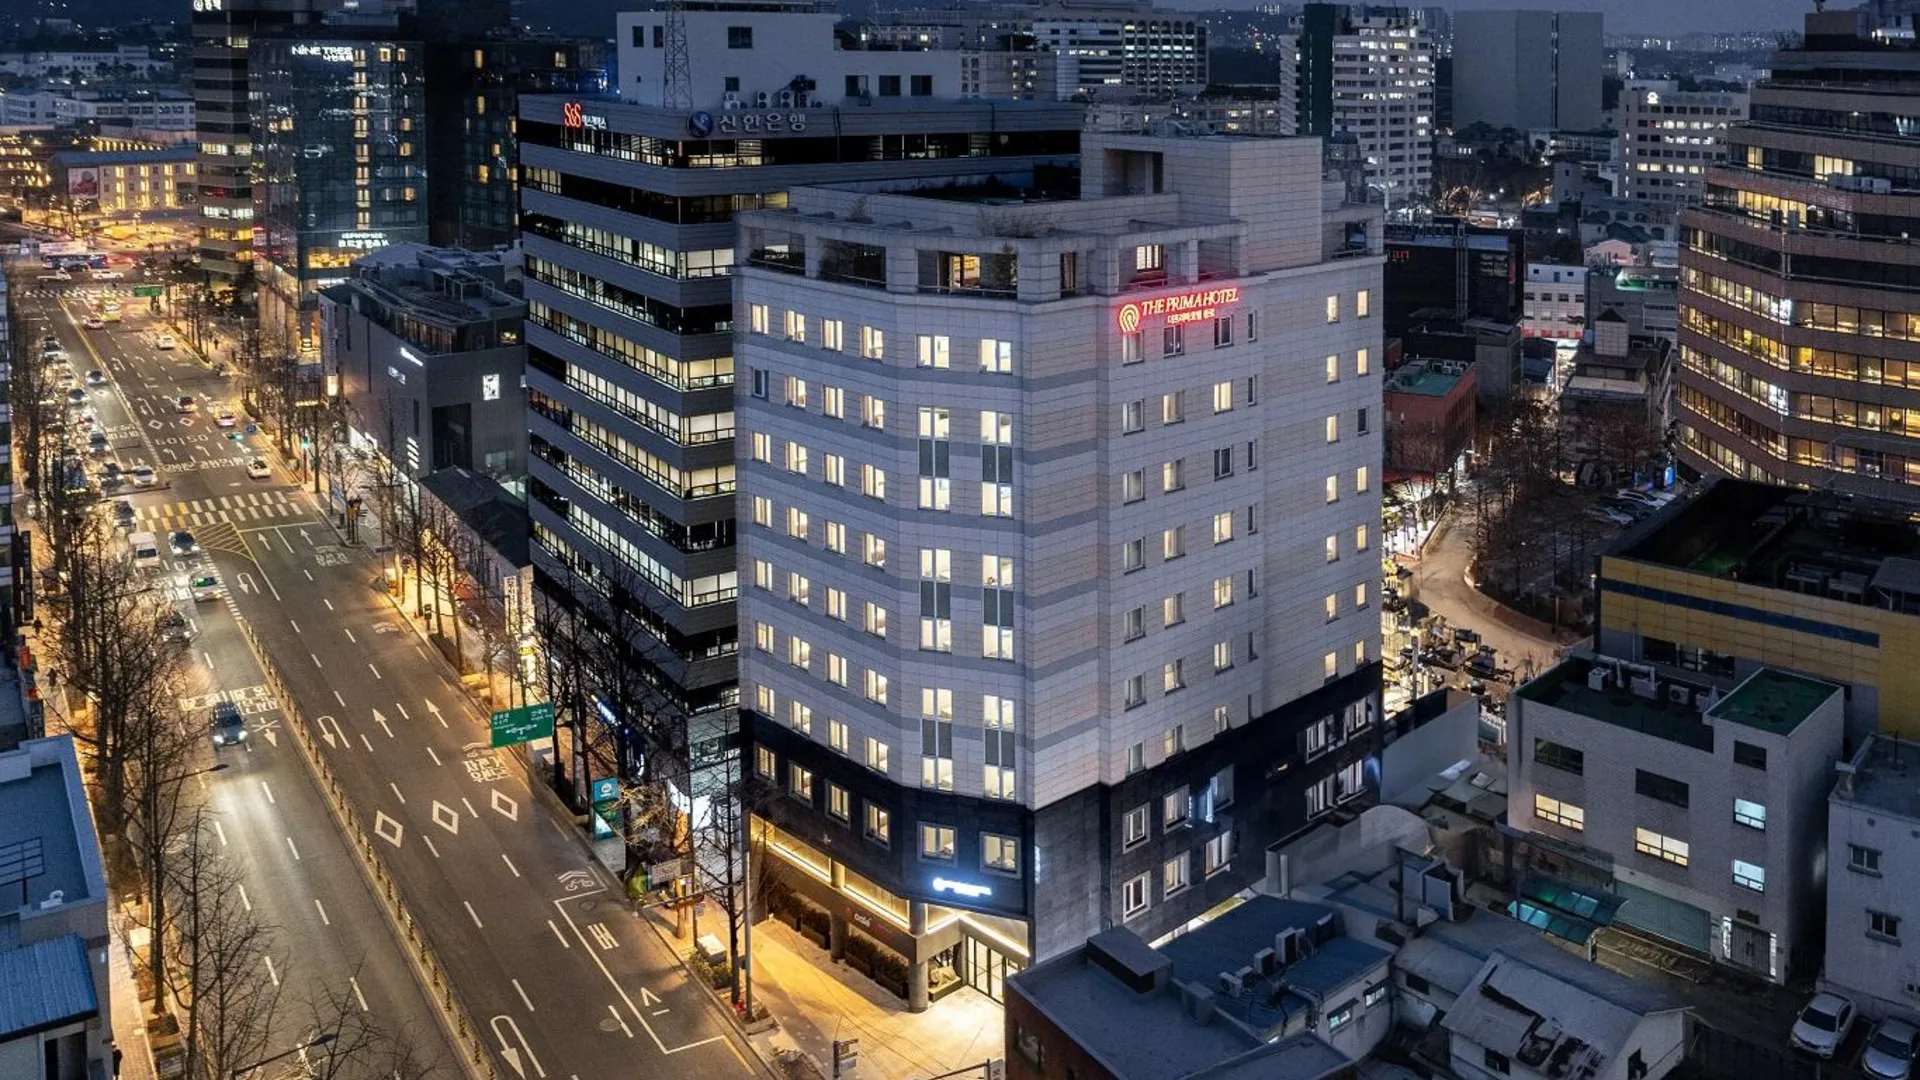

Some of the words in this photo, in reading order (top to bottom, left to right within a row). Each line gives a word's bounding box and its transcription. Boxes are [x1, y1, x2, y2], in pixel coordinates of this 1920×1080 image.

[720, 113, 806, 133] 신한은행
[1141, 299, 1165, 316] THE
[1166, 294, 1203, 312] PRIMA
[1203, 288, 1239, 307] HOTEL
